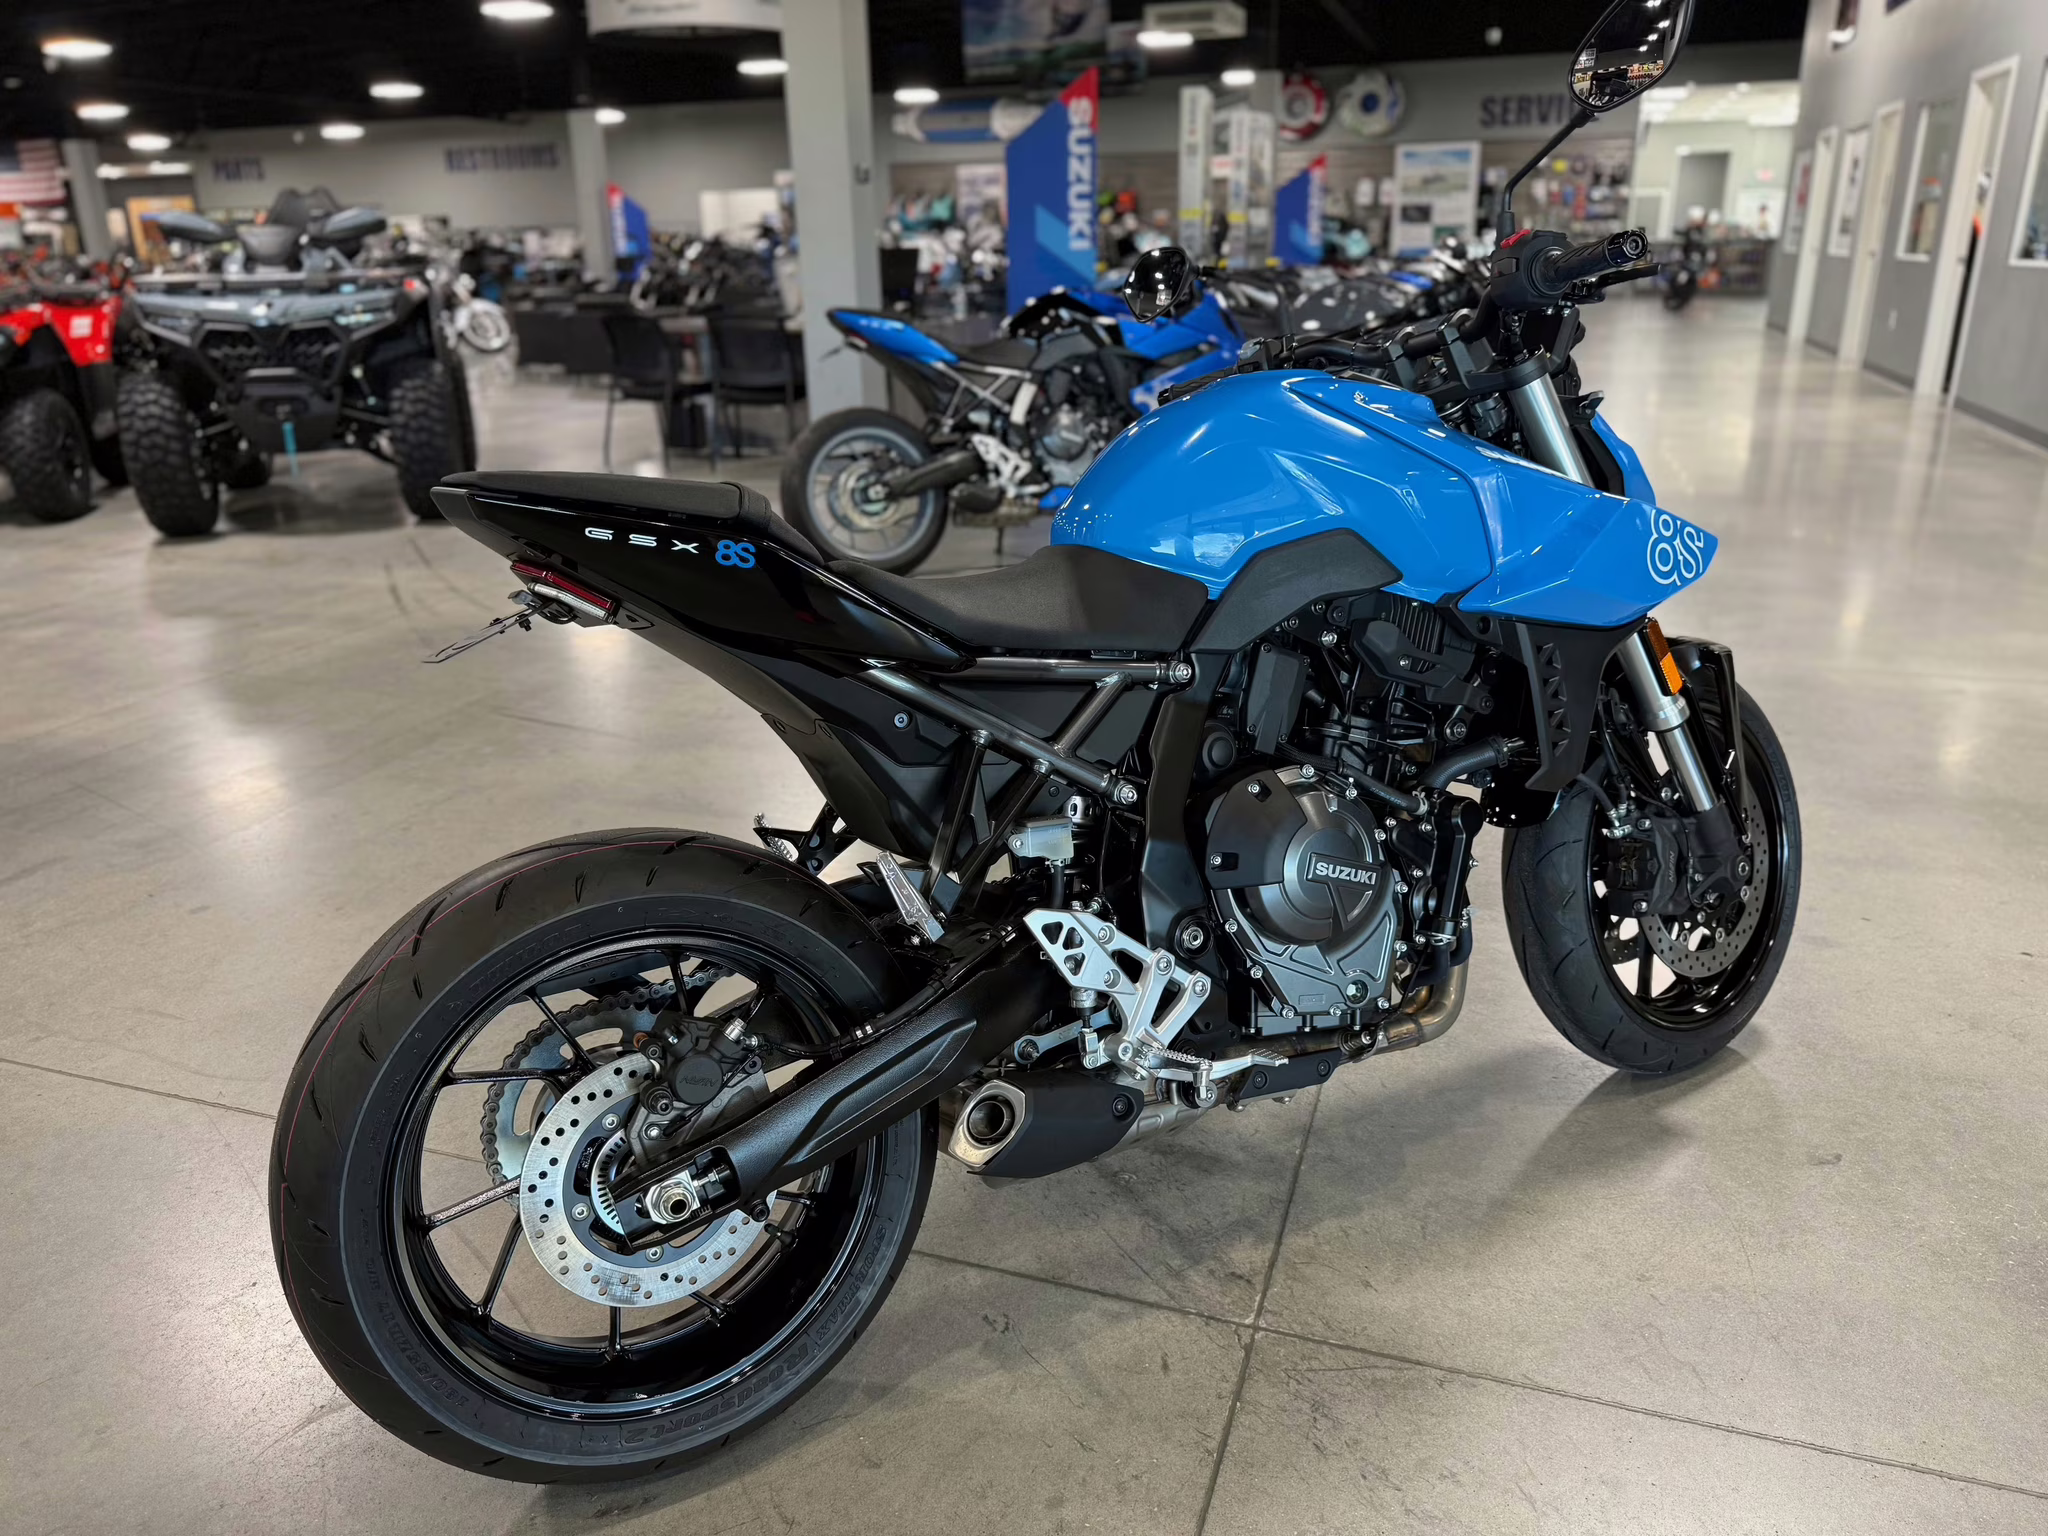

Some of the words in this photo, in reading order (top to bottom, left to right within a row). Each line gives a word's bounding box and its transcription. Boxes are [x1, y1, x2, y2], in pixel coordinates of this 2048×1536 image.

[1481, 93, 1575, 129] SERVI
[1067, 96, 1092, 251] SUZUKI
[715, 539, 756, 569] 8S
[1315, 862, 1377, 885] SUZUKI
[815, 1224, 887, 1340] SPORTMAX
